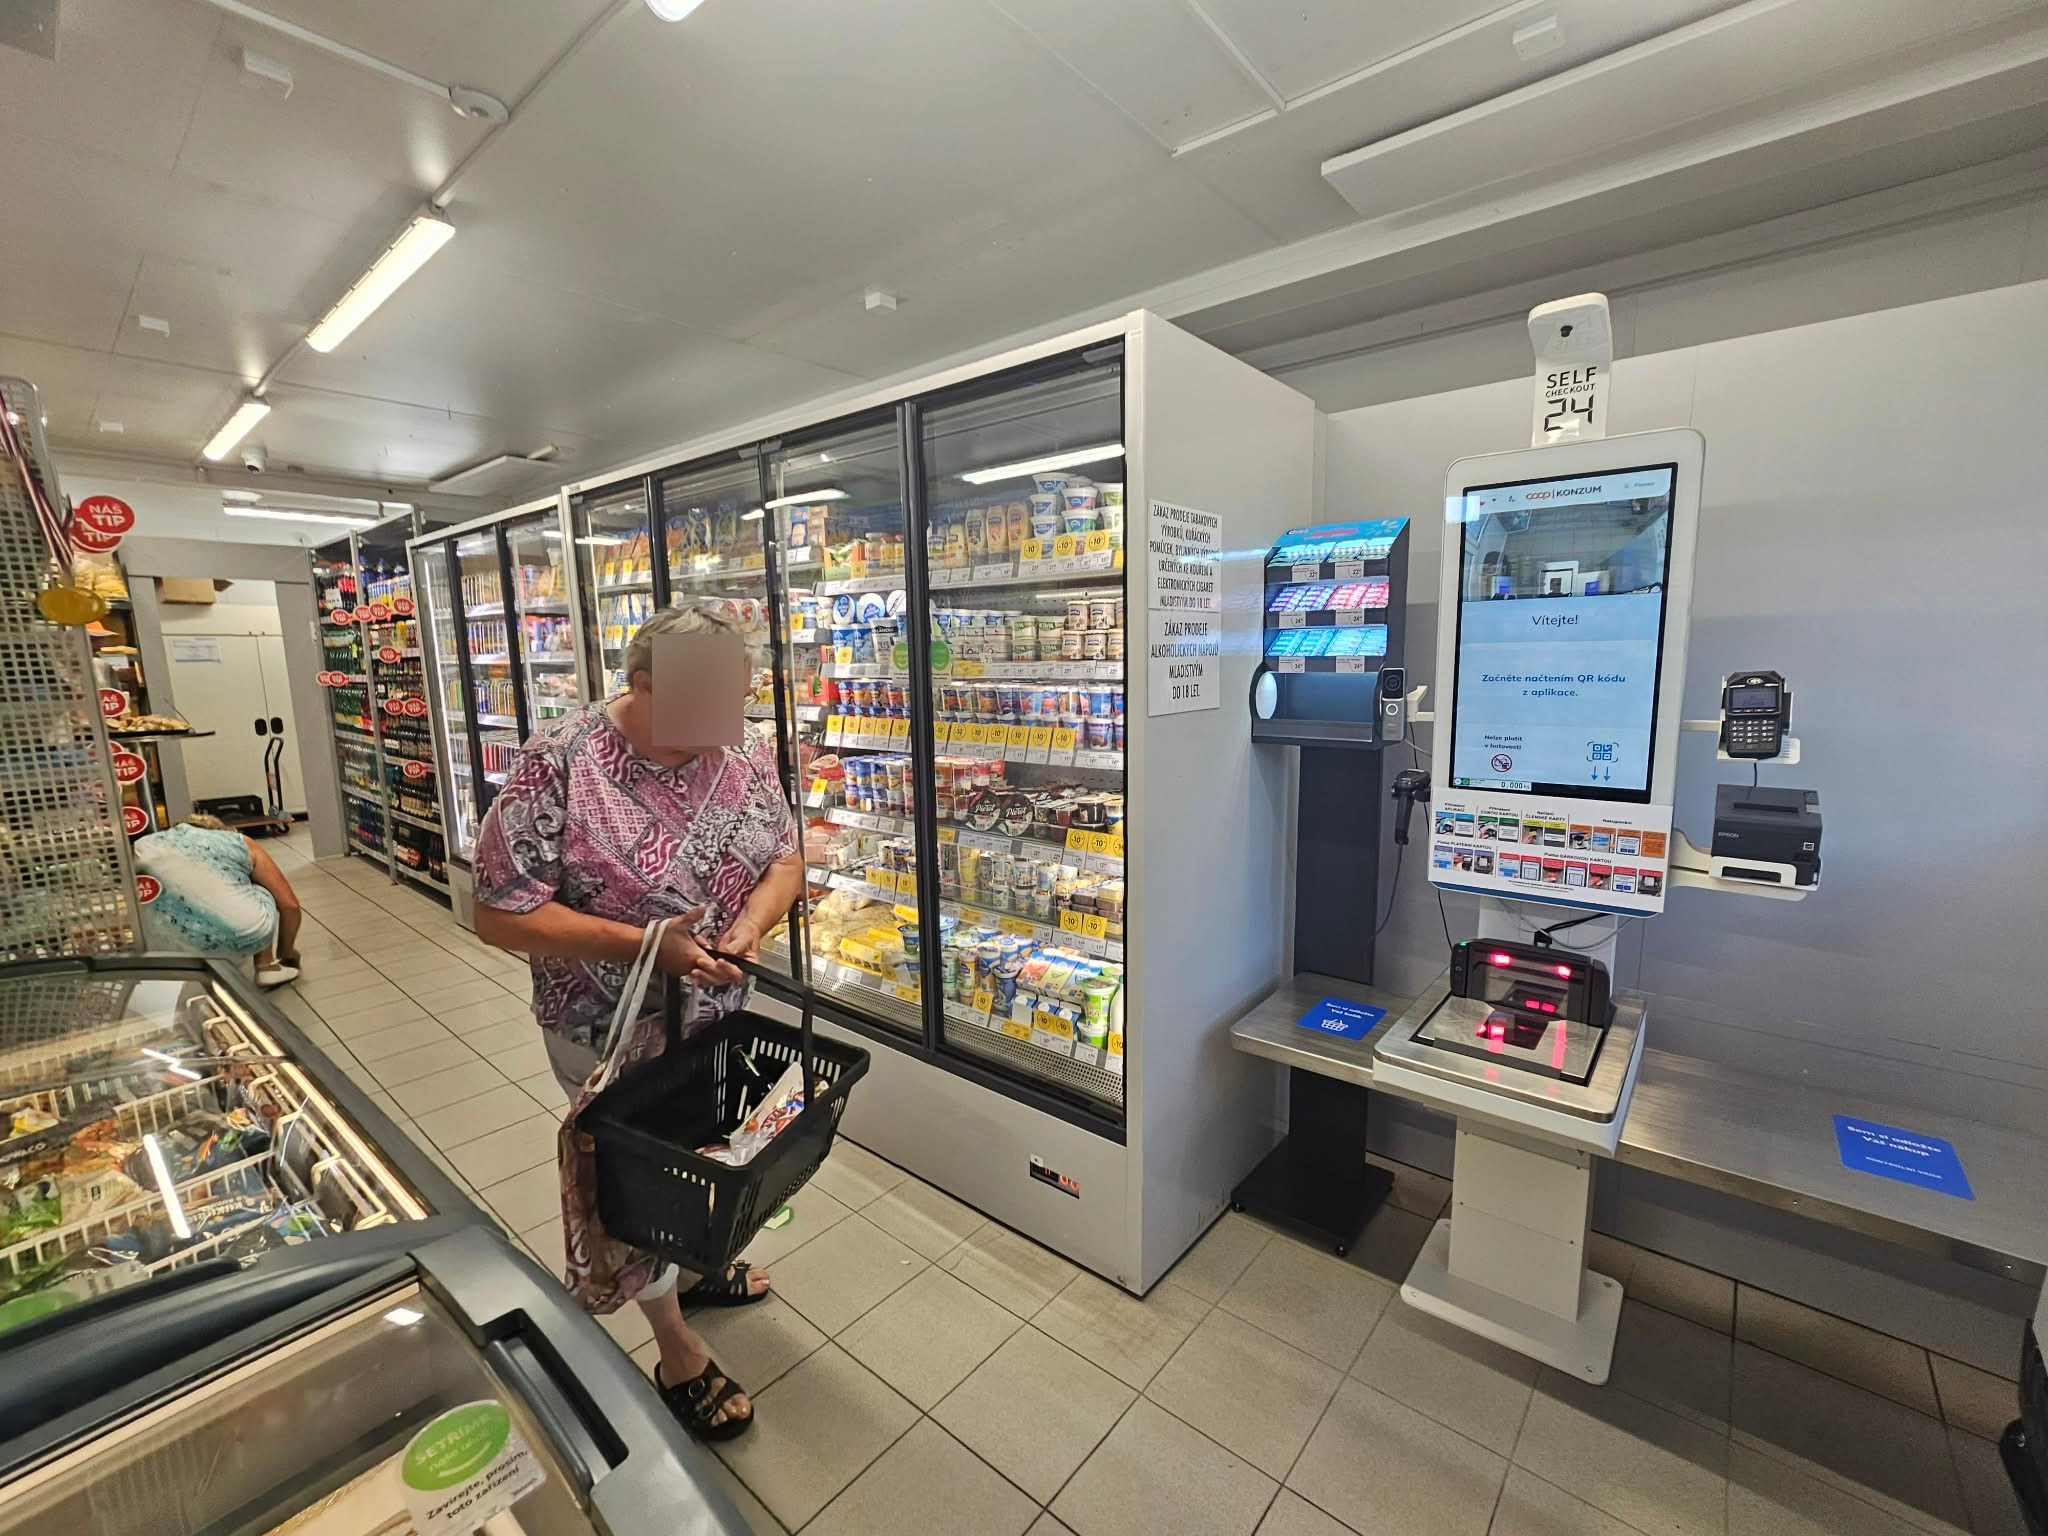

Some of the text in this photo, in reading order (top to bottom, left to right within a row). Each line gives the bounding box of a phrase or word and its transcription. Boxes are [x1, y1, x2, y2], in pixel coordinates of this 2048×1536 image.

[1546, 366, 1597, 389] SELF
[1545, 383, 1596, 398] CHECKOUT
[1544, 394, 1594, 432] 24
[1556, 486, 1602, 497] KONZUM
[92, 514, 126, 527] TIP
[1531, 615, 1579, 627] Vítejte!
[1184, 622, 1208, 636] PRODEJE
[1168, 660, 1203, 679] MLADISTVÝM
[1481, 673, 1626, 683] Začněte načtením QR kódu
[1172, 685, 1181, 700] DO
[1182, 684, 1189, 699] 18
[1531, 688, 1579, 698] aplikace.
[103, 702, 120, 711] IP
[1847, 1126, 1942, 1153] Sem si odložte
[1862, 1135, 1930, 1157] Váš nákup
[446, 1499, 473, 1519] toto
